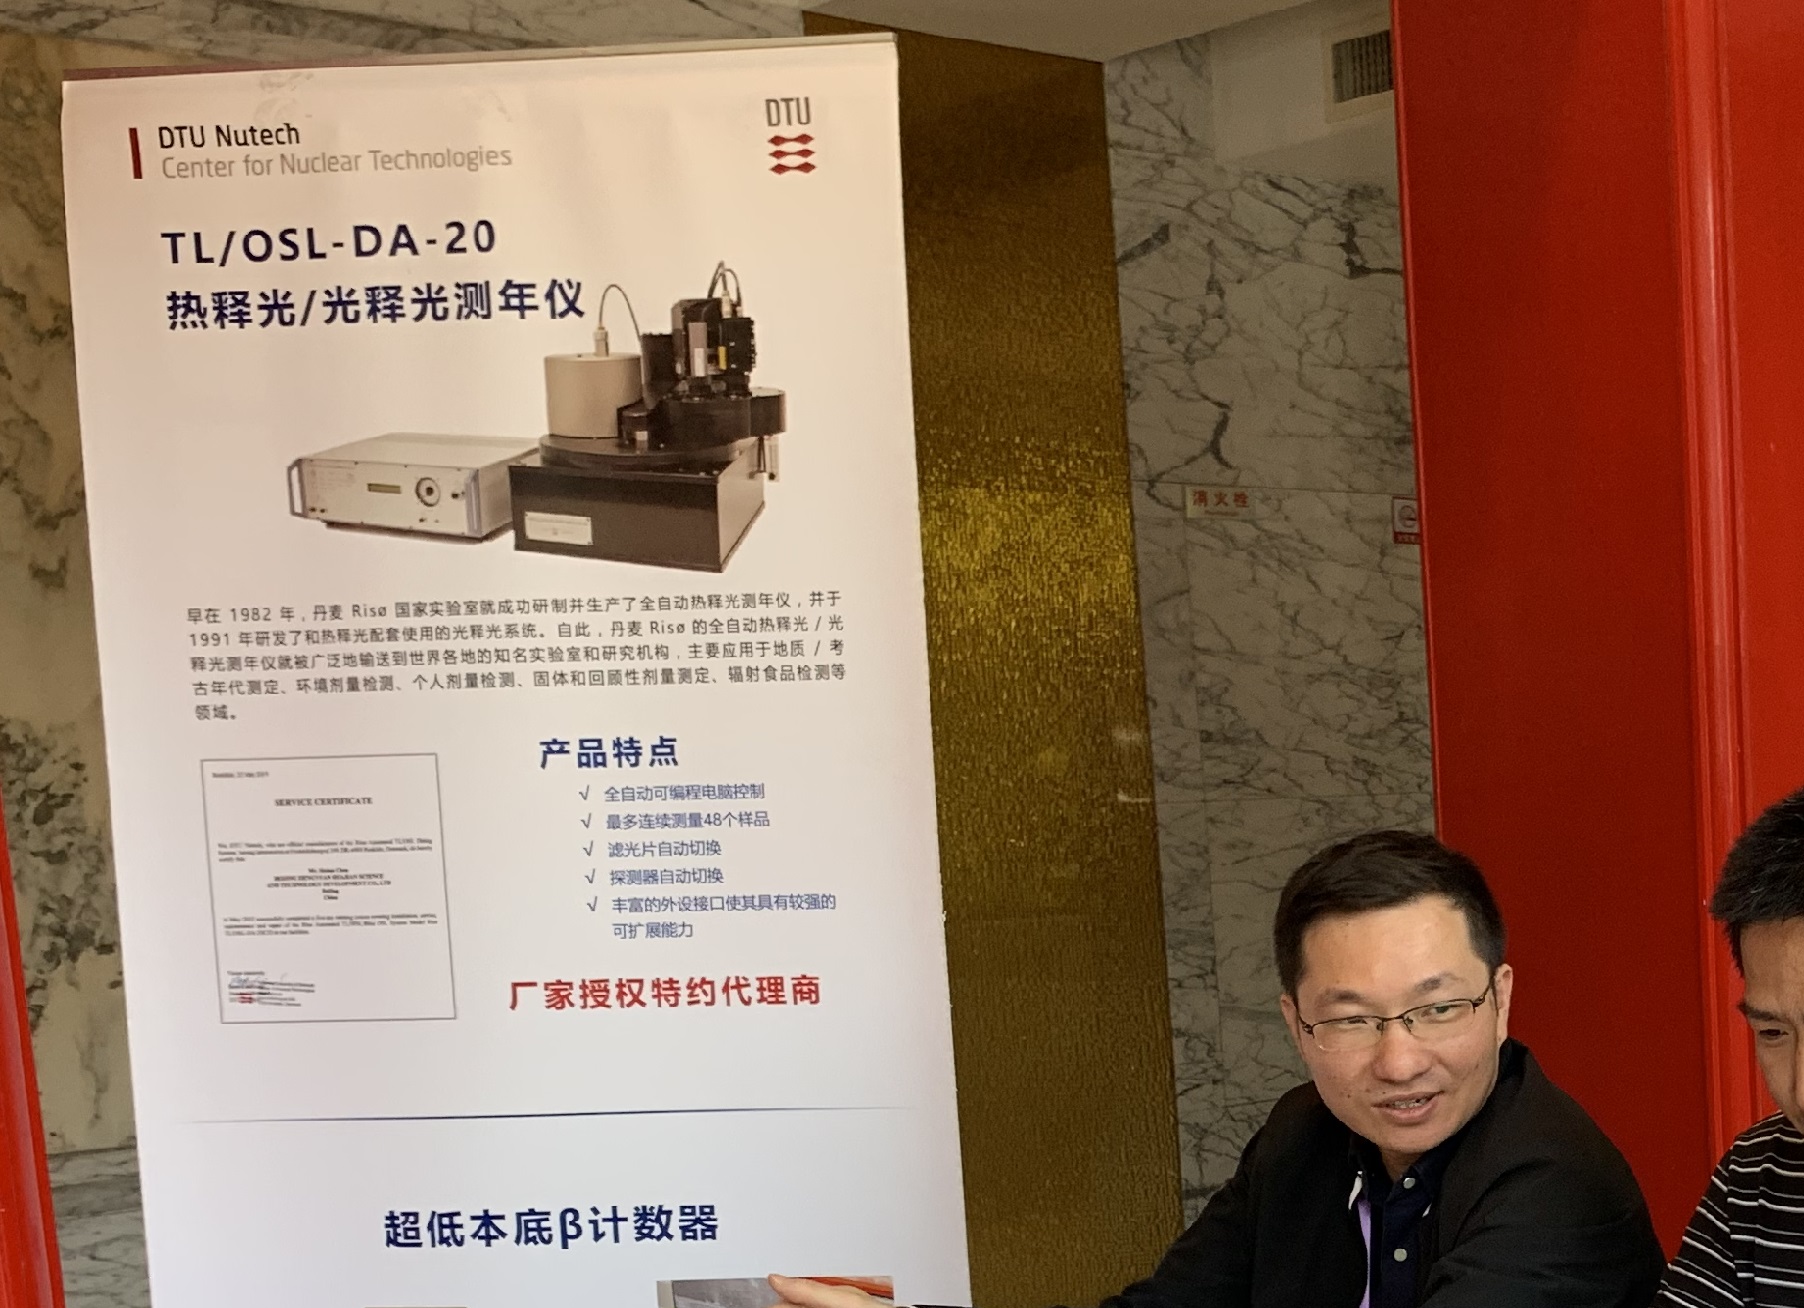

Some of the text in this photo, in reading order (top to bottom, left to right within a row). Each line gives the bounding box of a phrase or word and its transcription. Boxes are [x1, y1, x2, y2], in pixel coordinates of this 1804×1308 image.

[765, 97, 811, 127] DTU
[158, 123, 300, 149] DTU Nutech
[162, 146, 513, 179] Center for Nuclear Technologies
[160, 219, 496, 267] TL/OSL-DA-20
[165, 277, 586, 331] 热释光/光释光测年仪
[187, 607, 222, 625] 早在
[230, 606, 272, 622] 1982
[352, 603, 387, 618] Risø
[189, 632, 231, 647] 1991
[650, 620, 686, 635] Risø
[539, 735, 679, 769] 产品特点
[604, 783, 765, 803] 全自动可编程电脑控制
[606, 810, 770, 830] 最多连续测量48个样品
[607, 839, 722, 858] 滤光片自动切换
[609, 867, 725, 886] 探测器自动切换
[611, 893, 836, 914] 丰富的外设接口使其具有较强的
[612, 921, 693, 940] 可扩展能力
[509, 974, 820, 1011] 厂家授权特约代理商
[384, 1203, 719, 1249] 超低本底β计数器
